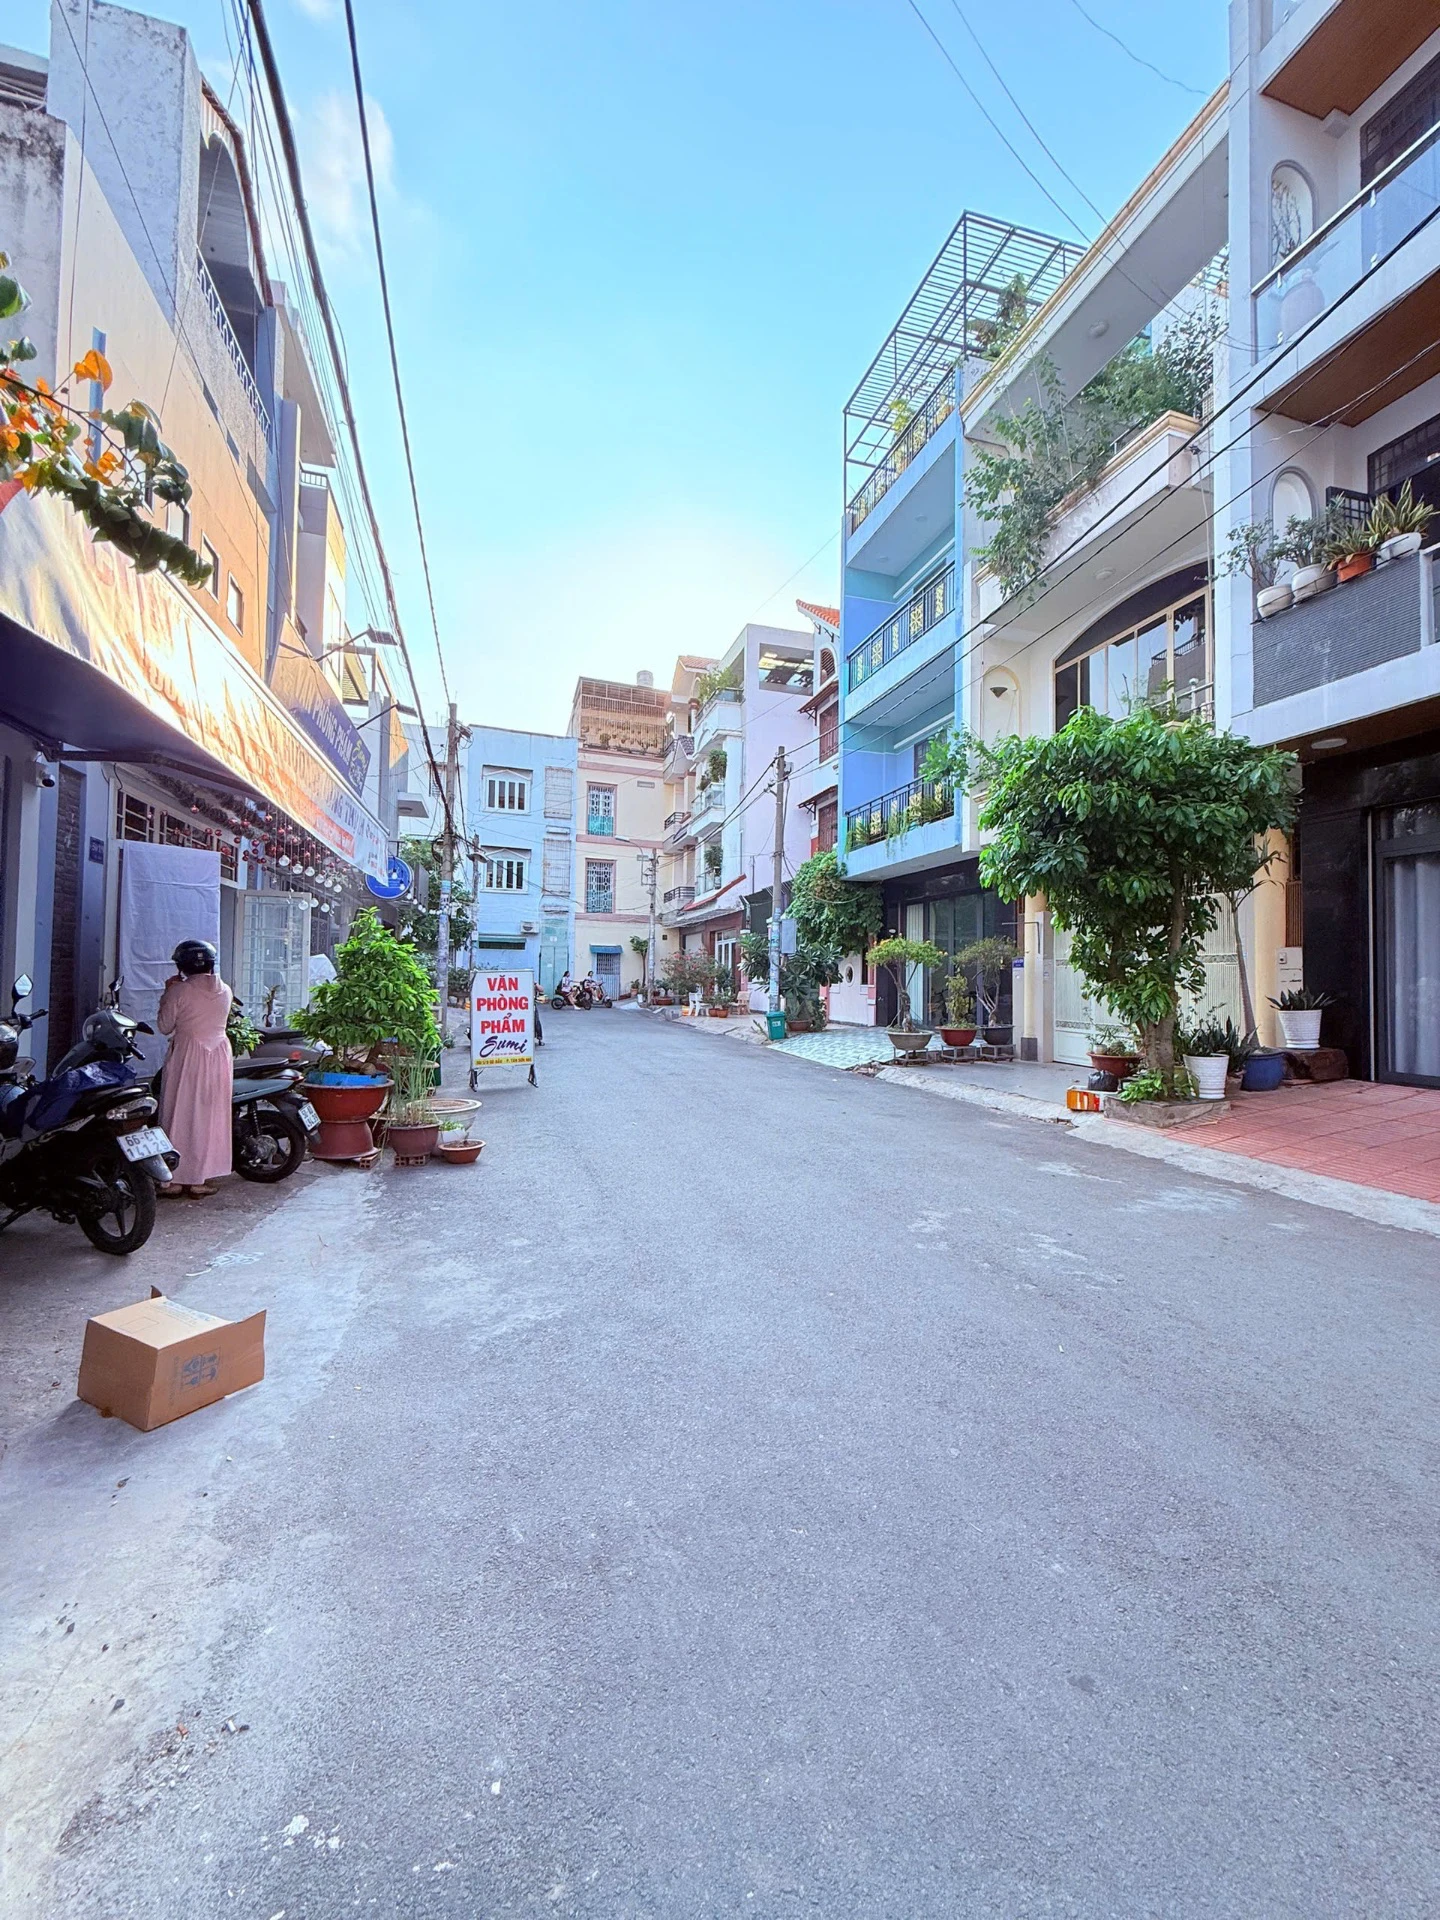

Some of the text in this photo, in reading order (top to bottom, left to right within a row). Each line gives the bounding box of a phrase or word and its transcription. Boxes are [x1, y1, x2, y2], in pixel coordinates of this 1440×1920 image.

[311, 693, 338, 745] PHÒNG
[333, 724, 355, 766] PHẨM
[487, 975, 518, 991] VĂN
[476, 993, 529, 1011] PHÒNG
[481, 1012, 525, 1034] PHẨM
[479, 1036, 528, 1058] Sumi
[125, 1130, 159, 1147] 66-C1
